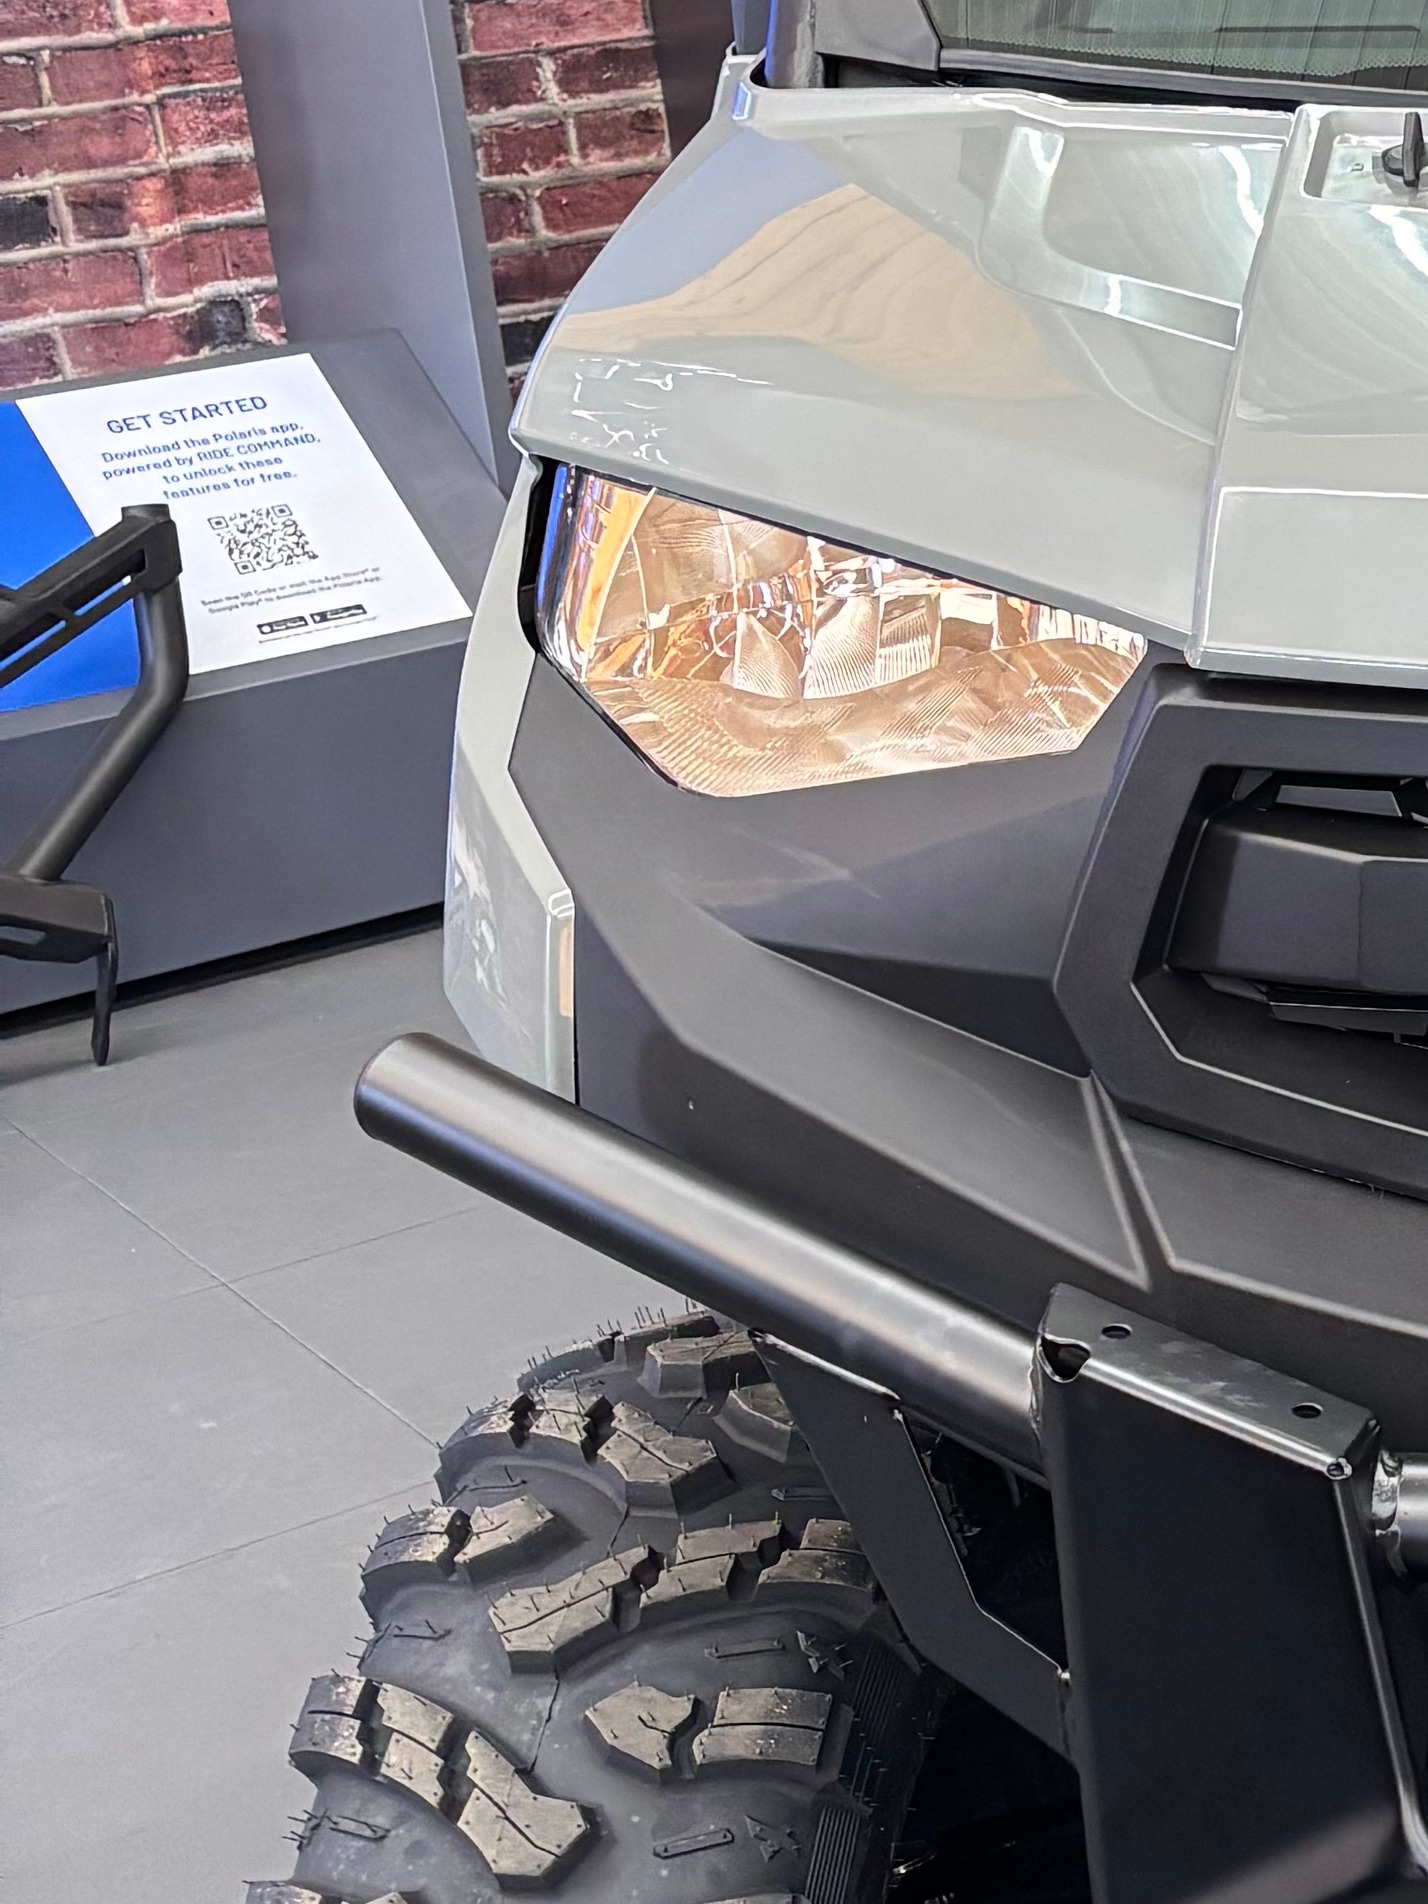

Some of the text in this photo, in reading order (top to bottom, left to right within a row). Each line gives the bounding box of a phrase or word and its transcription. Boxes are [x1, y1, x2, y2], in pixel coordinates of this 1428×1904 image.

[107, 395, 268, 434] GET STARTED
[101, 440, 182, 463] Download
[183, 437, 211, 450] the
[212, 427, 267, 444] Polaris
[102, 459, 173, 481] powered
[175, 454, 194, 467] by
[197, 447, 235, 463] RIDE
[163, 456, 284, 485] to unlock these
[163, 480, 232, 500] features
[233, 476, 256, 489] for
